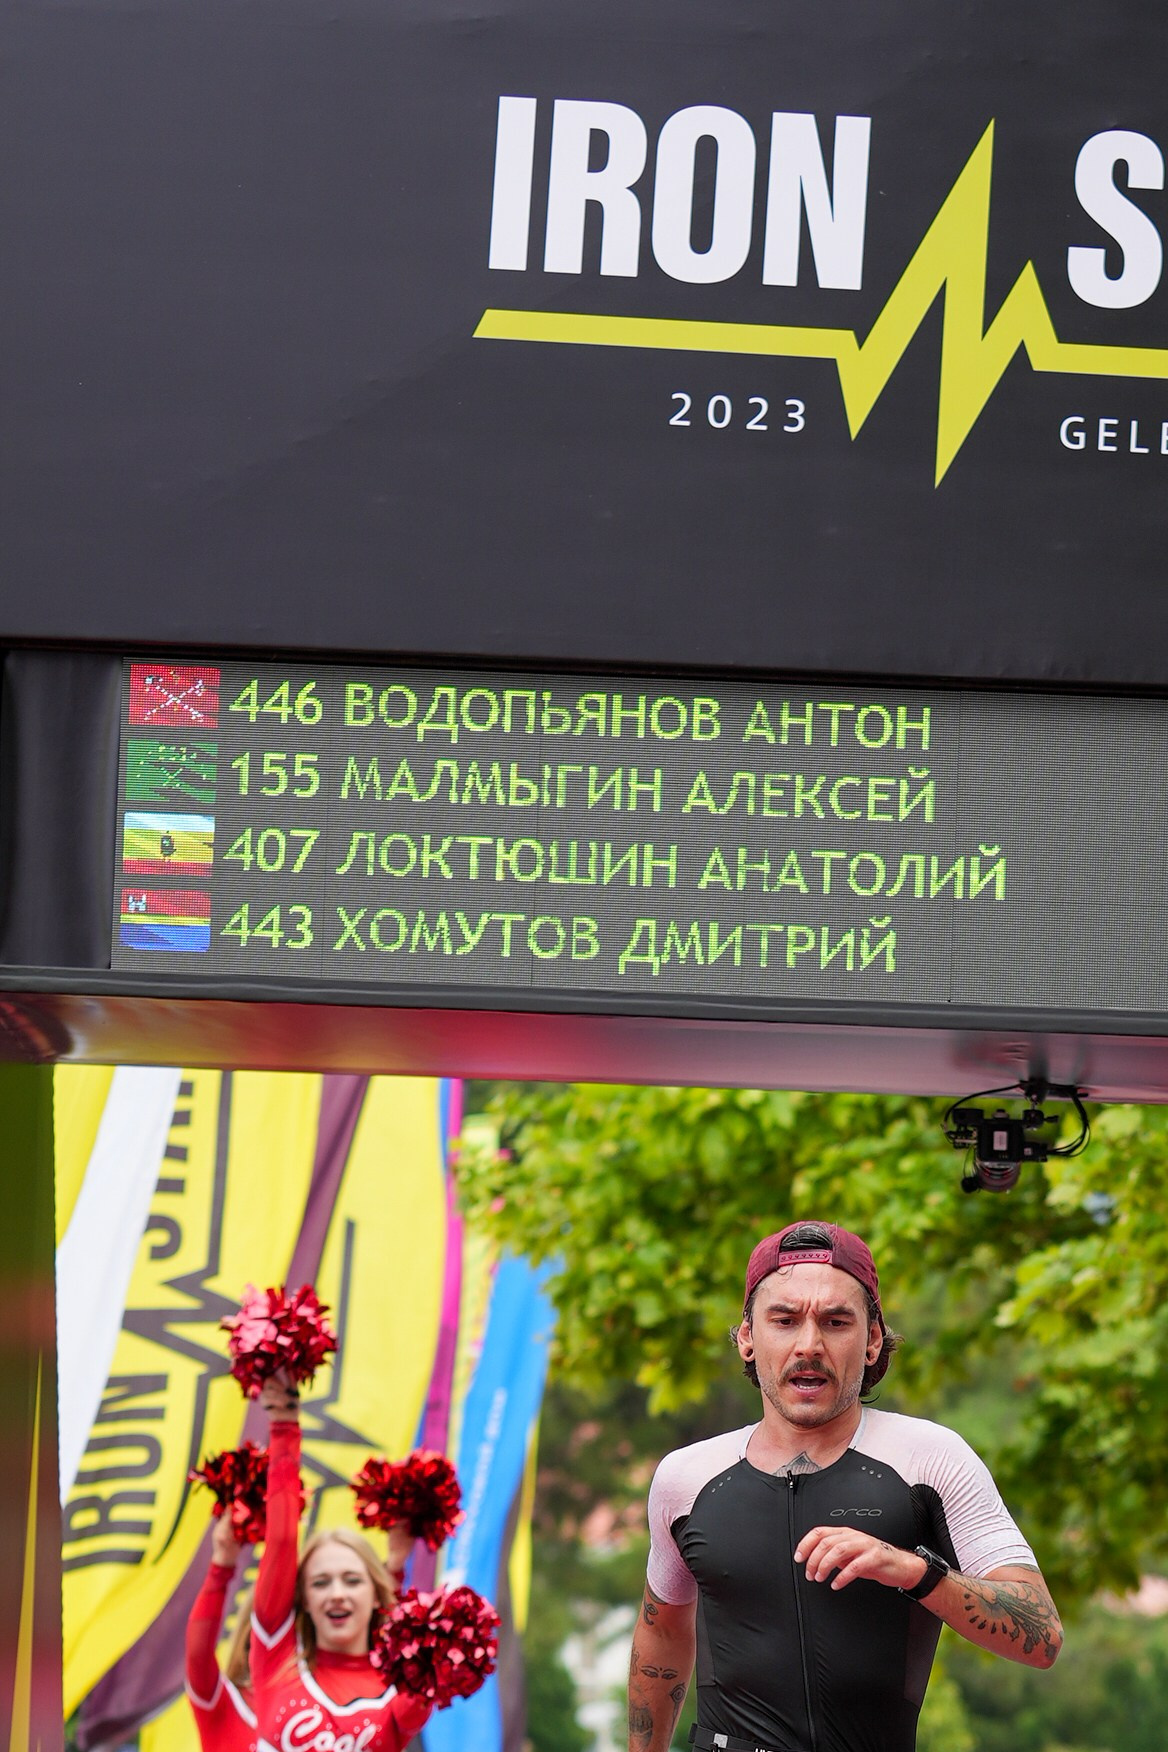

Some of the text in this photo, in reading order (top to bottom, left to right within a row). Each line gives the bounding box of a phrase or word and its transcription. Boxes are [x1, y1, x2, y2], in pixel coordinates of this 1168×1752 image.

[489, 95, 871, 291] IRON
[669, 392, 805, 433] 2023
[229, 678, 323, 725] 446
[344, 682, 721, 742] ВОДОПЬЯНОВ
[744, 700, 932, 749] АНТОН
[231, 752, 320, 797] 155
[340, 757, 663, 814] МАЛМЫГИН
[682, 766, 935, 822] АЛЕКСЕЙ
[224, 827, 321, 872] 407
[336, 831, 678, 890] ЛОКТЮШИН
[699, 844, 1007, 900] АНАТОЛИЙ
[221, 903, 314, 948] 443
[334, 908, 601, 959] ХОМУТОВ
[618, 916, 897, 975] ДМИТРИЙ
[829, 1508, 883, 1517] orca
